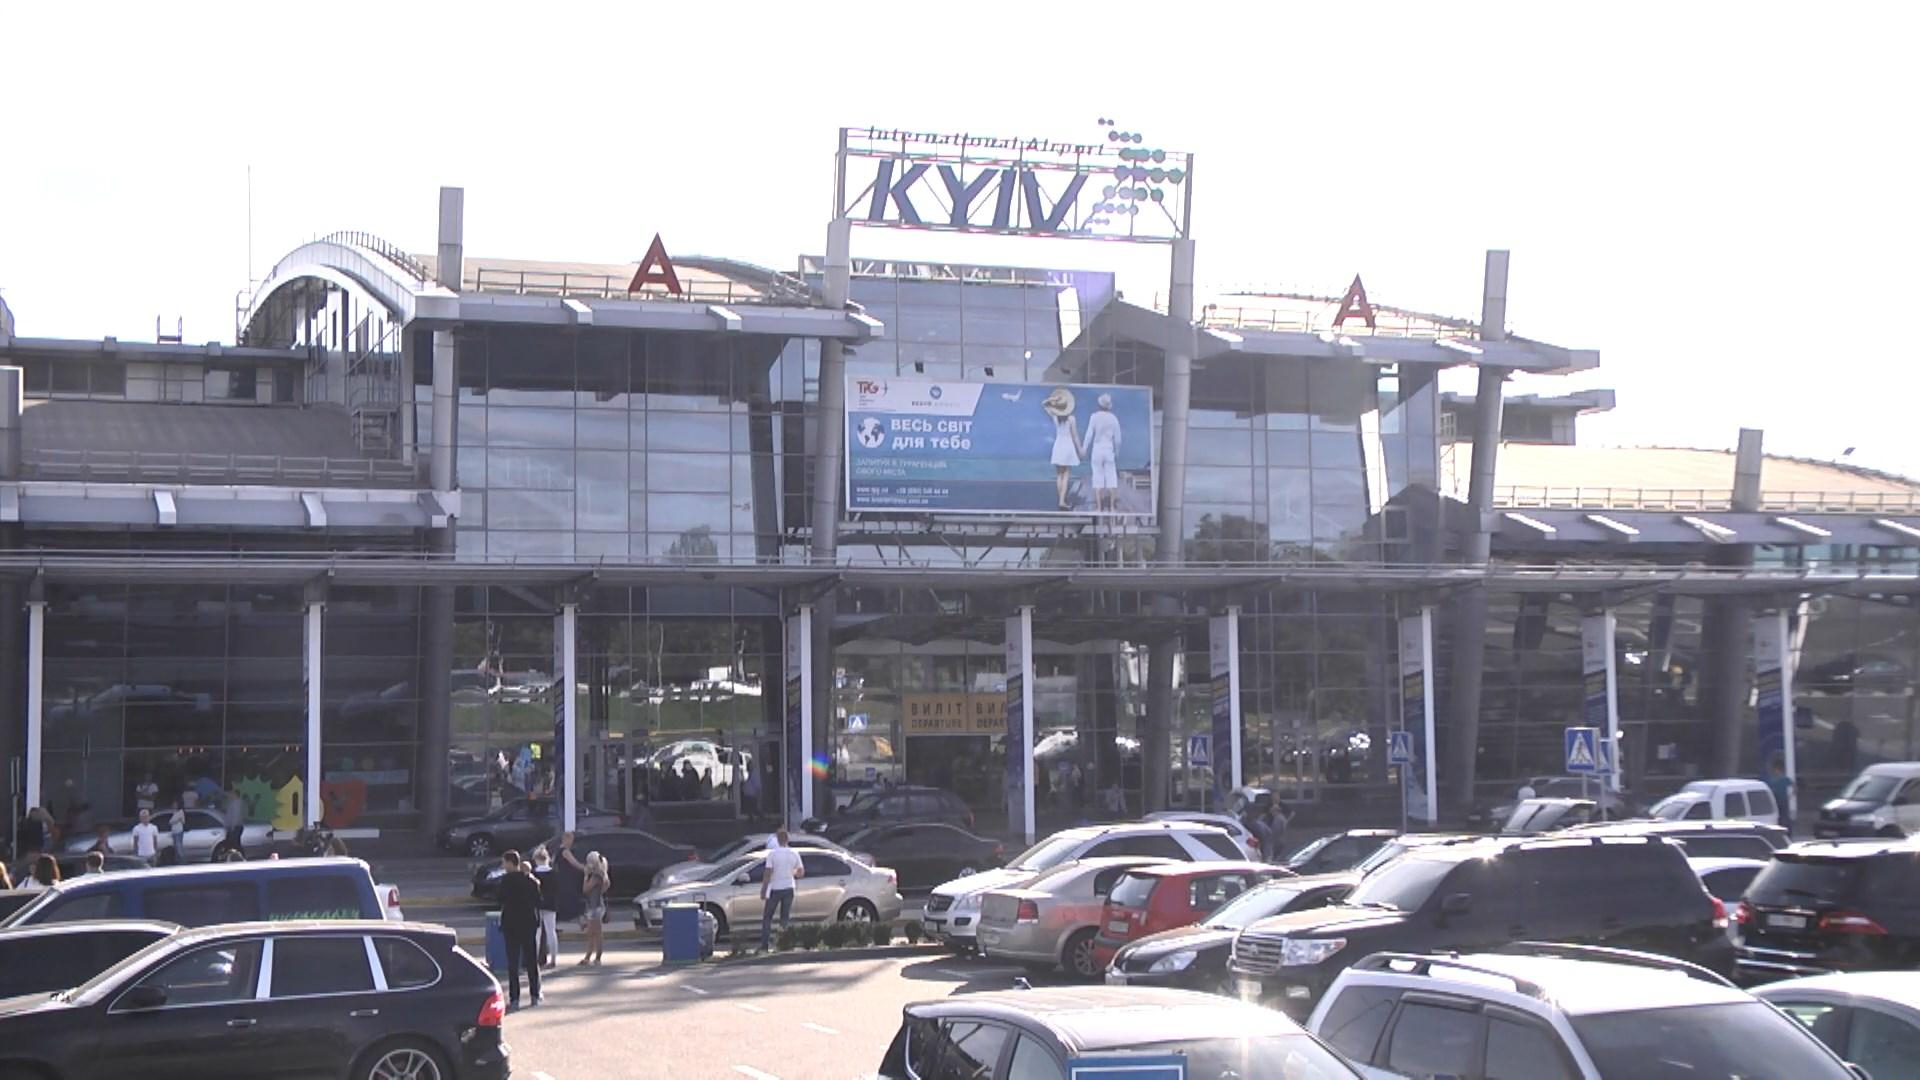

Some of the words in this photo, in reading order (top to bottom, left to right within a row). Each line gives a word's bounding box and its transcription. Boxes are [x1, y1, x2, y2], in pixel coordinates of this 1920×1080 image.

[868, 125, 1018, 150] International
[1025, 136, 1104, 157] Airport
[868, 159, 1089, 231] KYIV
[628, 232, 682, 295] A
[1332, 273, 1376, 328] A
[890, 418, 933, 433] ВЕСЬ
[937, 419, 973, 434] СВІТ
[891, 436, 925, 450] для
[929, 434, 972, 450] тебе
[911, 703, 962, 715] ВИЛІТ
[911, 719, 962, 728] DEPARTURE
